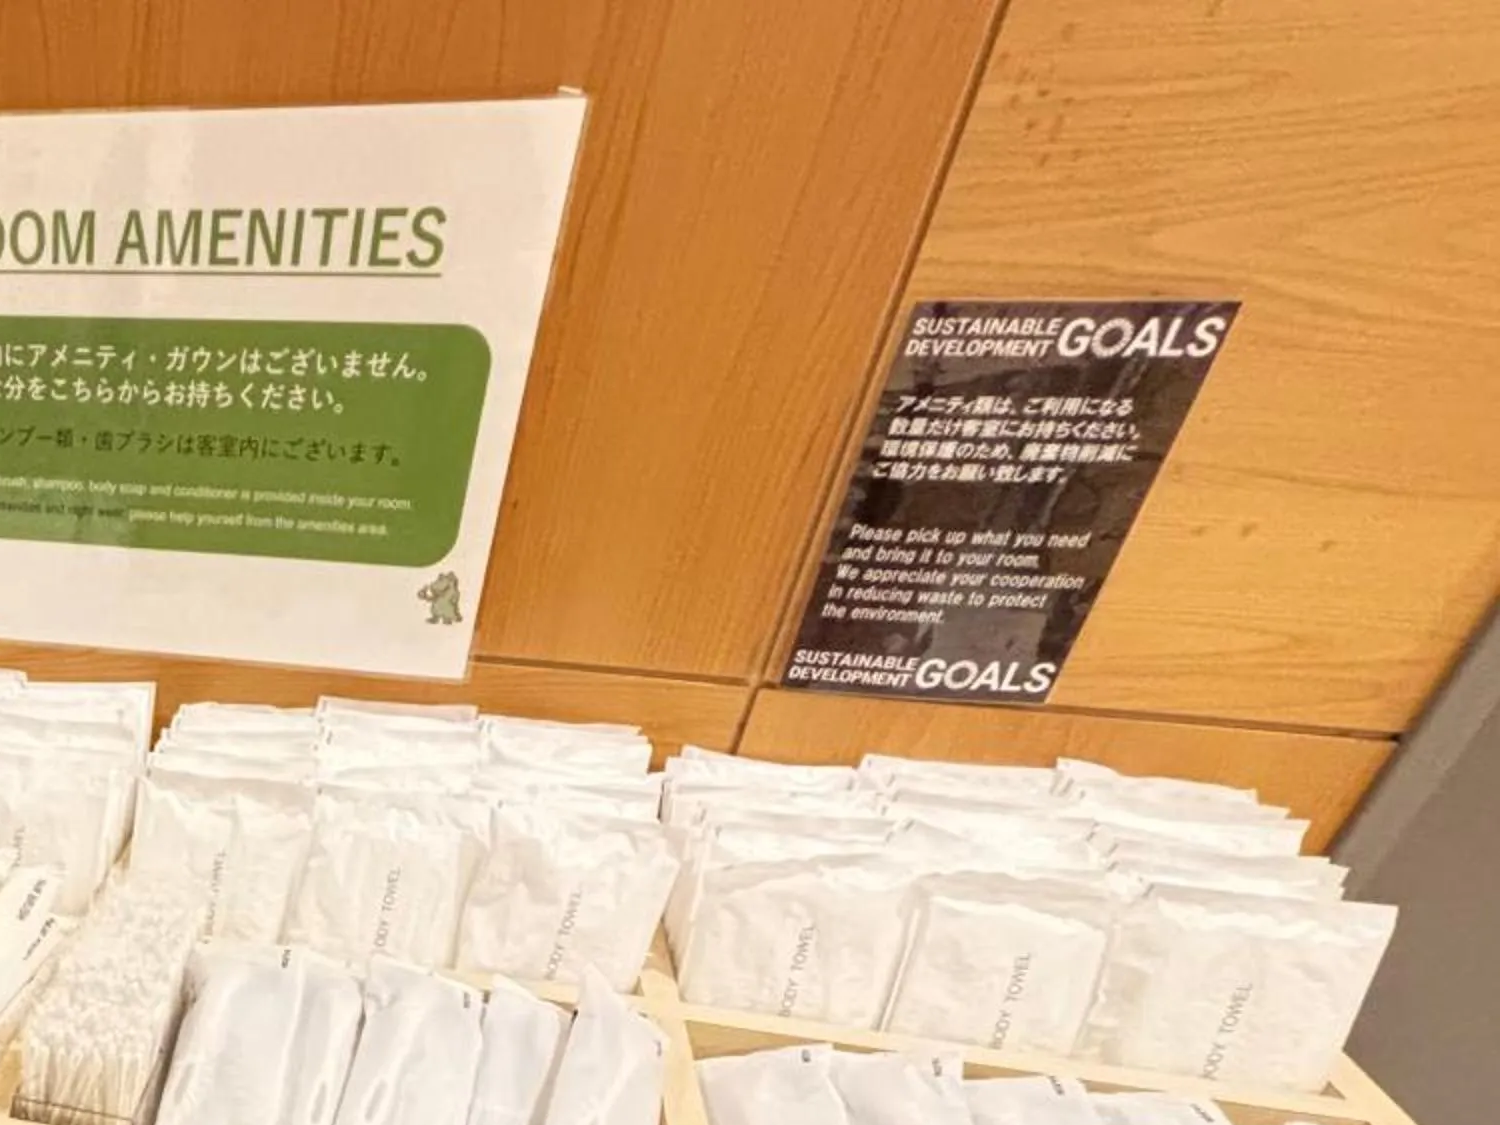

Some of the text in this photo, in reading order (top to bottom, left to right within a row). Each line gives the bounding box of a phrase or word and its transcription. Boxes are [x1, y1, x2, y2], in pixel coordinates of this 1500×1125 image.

[113, 205, 447, 269] AMENITIES
[904, 316, 1227, 359] DEVELOPMENT GOALS
[911, 316, 1064, 337] SUSTAINABLE
[849, 523, 1092, 550] Please pick up what you need
[841, 546, 871, 561] and
[875, 547, 915, 565] bring
[919, 549, 934, 564] it
[936, 550, 953, 565] to
[957, 553, 994, 570] your
[836, 563, 1086, 592] We appreciate your cooperation
[821, 602, 945, 624] the environment.
[827, 583, 1049, 609] in reducing waste to protect
[788, 657, 1056, 693] DEVELOPMENT GOALS
[794, 649, 920, 671] SUSTAINABLE
[381, 866, 402, 912] TOWEL
[557, 881, 583, 935] TOWEL
[789, 921, 817, 972] TOWEL
[1002, 951, 1032, 1003] TOWEL
[1217, 982, 1254, 1036] TOWEL
